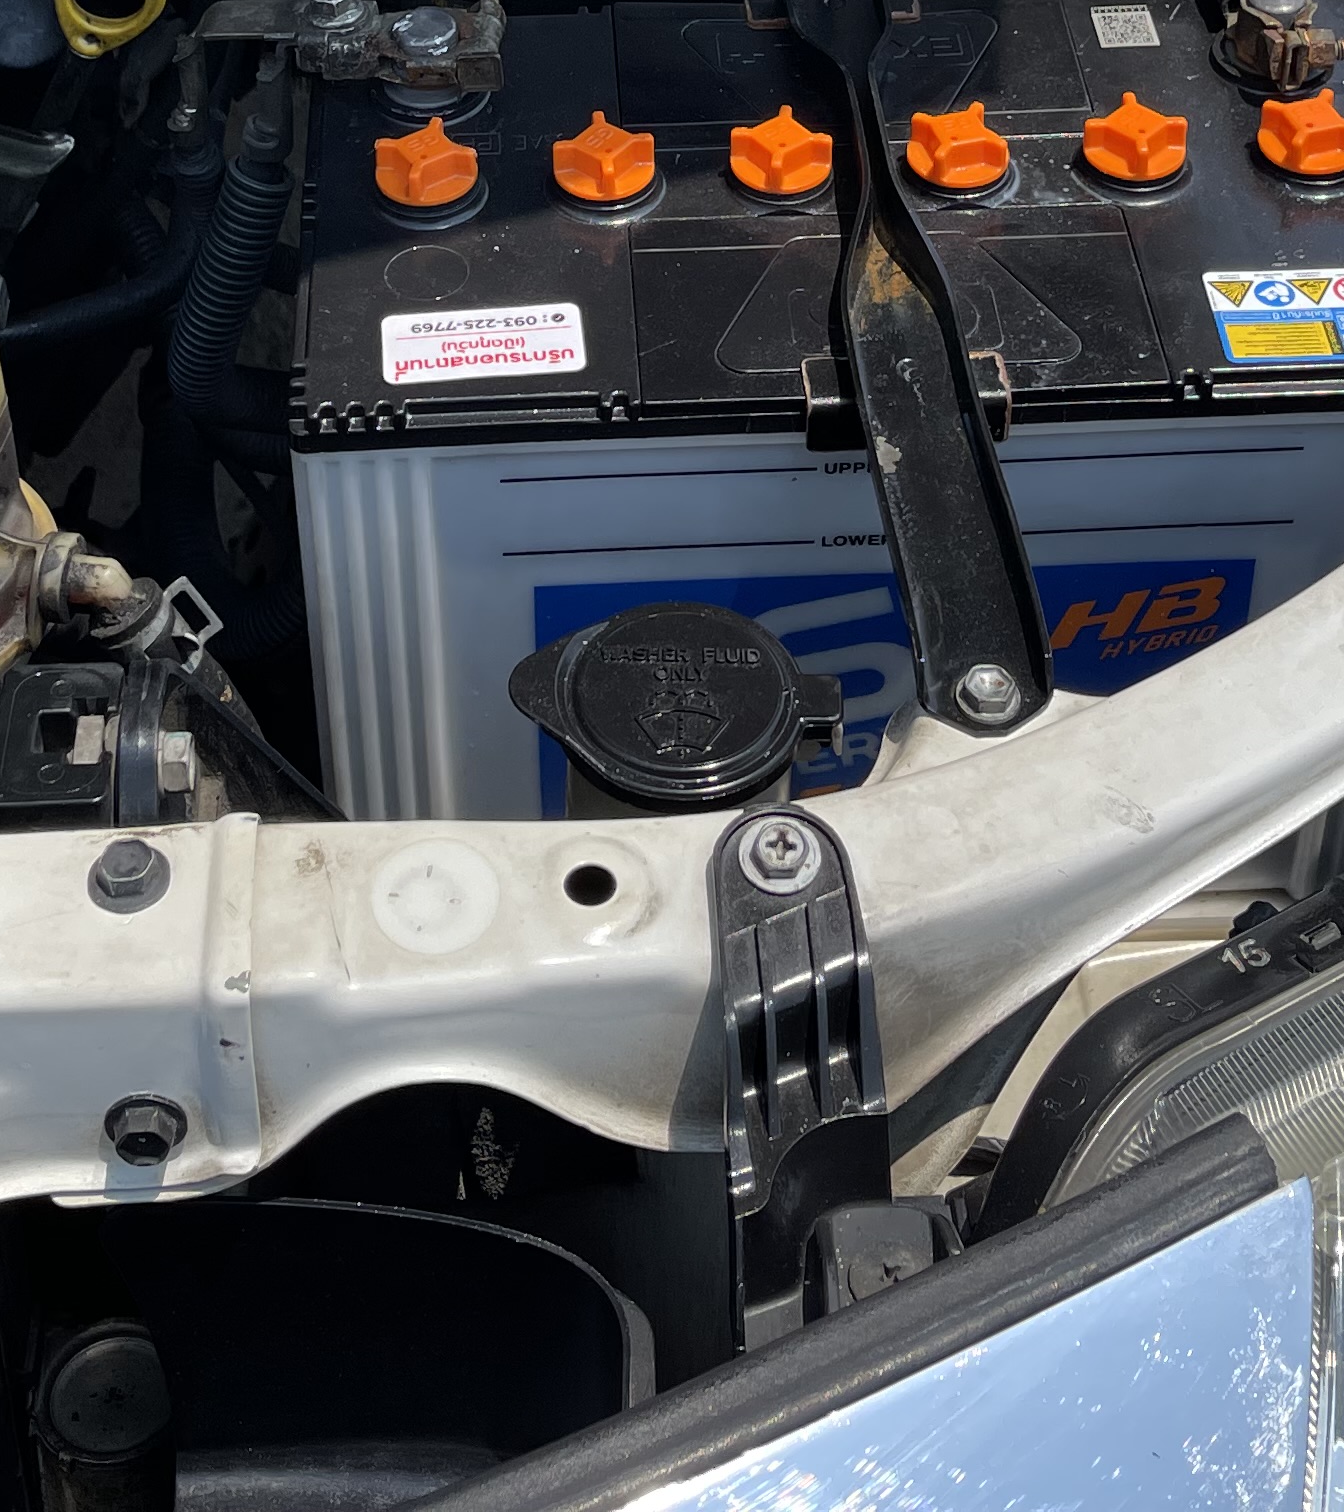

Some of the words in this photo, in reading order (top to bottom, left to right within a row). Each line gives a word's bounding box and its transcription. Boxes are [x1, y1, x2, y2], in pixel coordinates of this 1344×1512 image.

[411, 315, 538, 334] 093-225-7769
[441, 336, 526, 354] (เปิดทุกวัน)
[395, 349, 575, 382] บริการนอกสถานที่
[824, 462, 871, 475] UPP
[1050, 576, 1227, 650] HB
[1099, 624, 1220, 661] HYBRID
[599, 644, 691, 663] WASHER
[701, 646, 762, 665] FLUID
[653, 666, 709, 683] ONLY
[1220, 938, 1273, 975] 15
